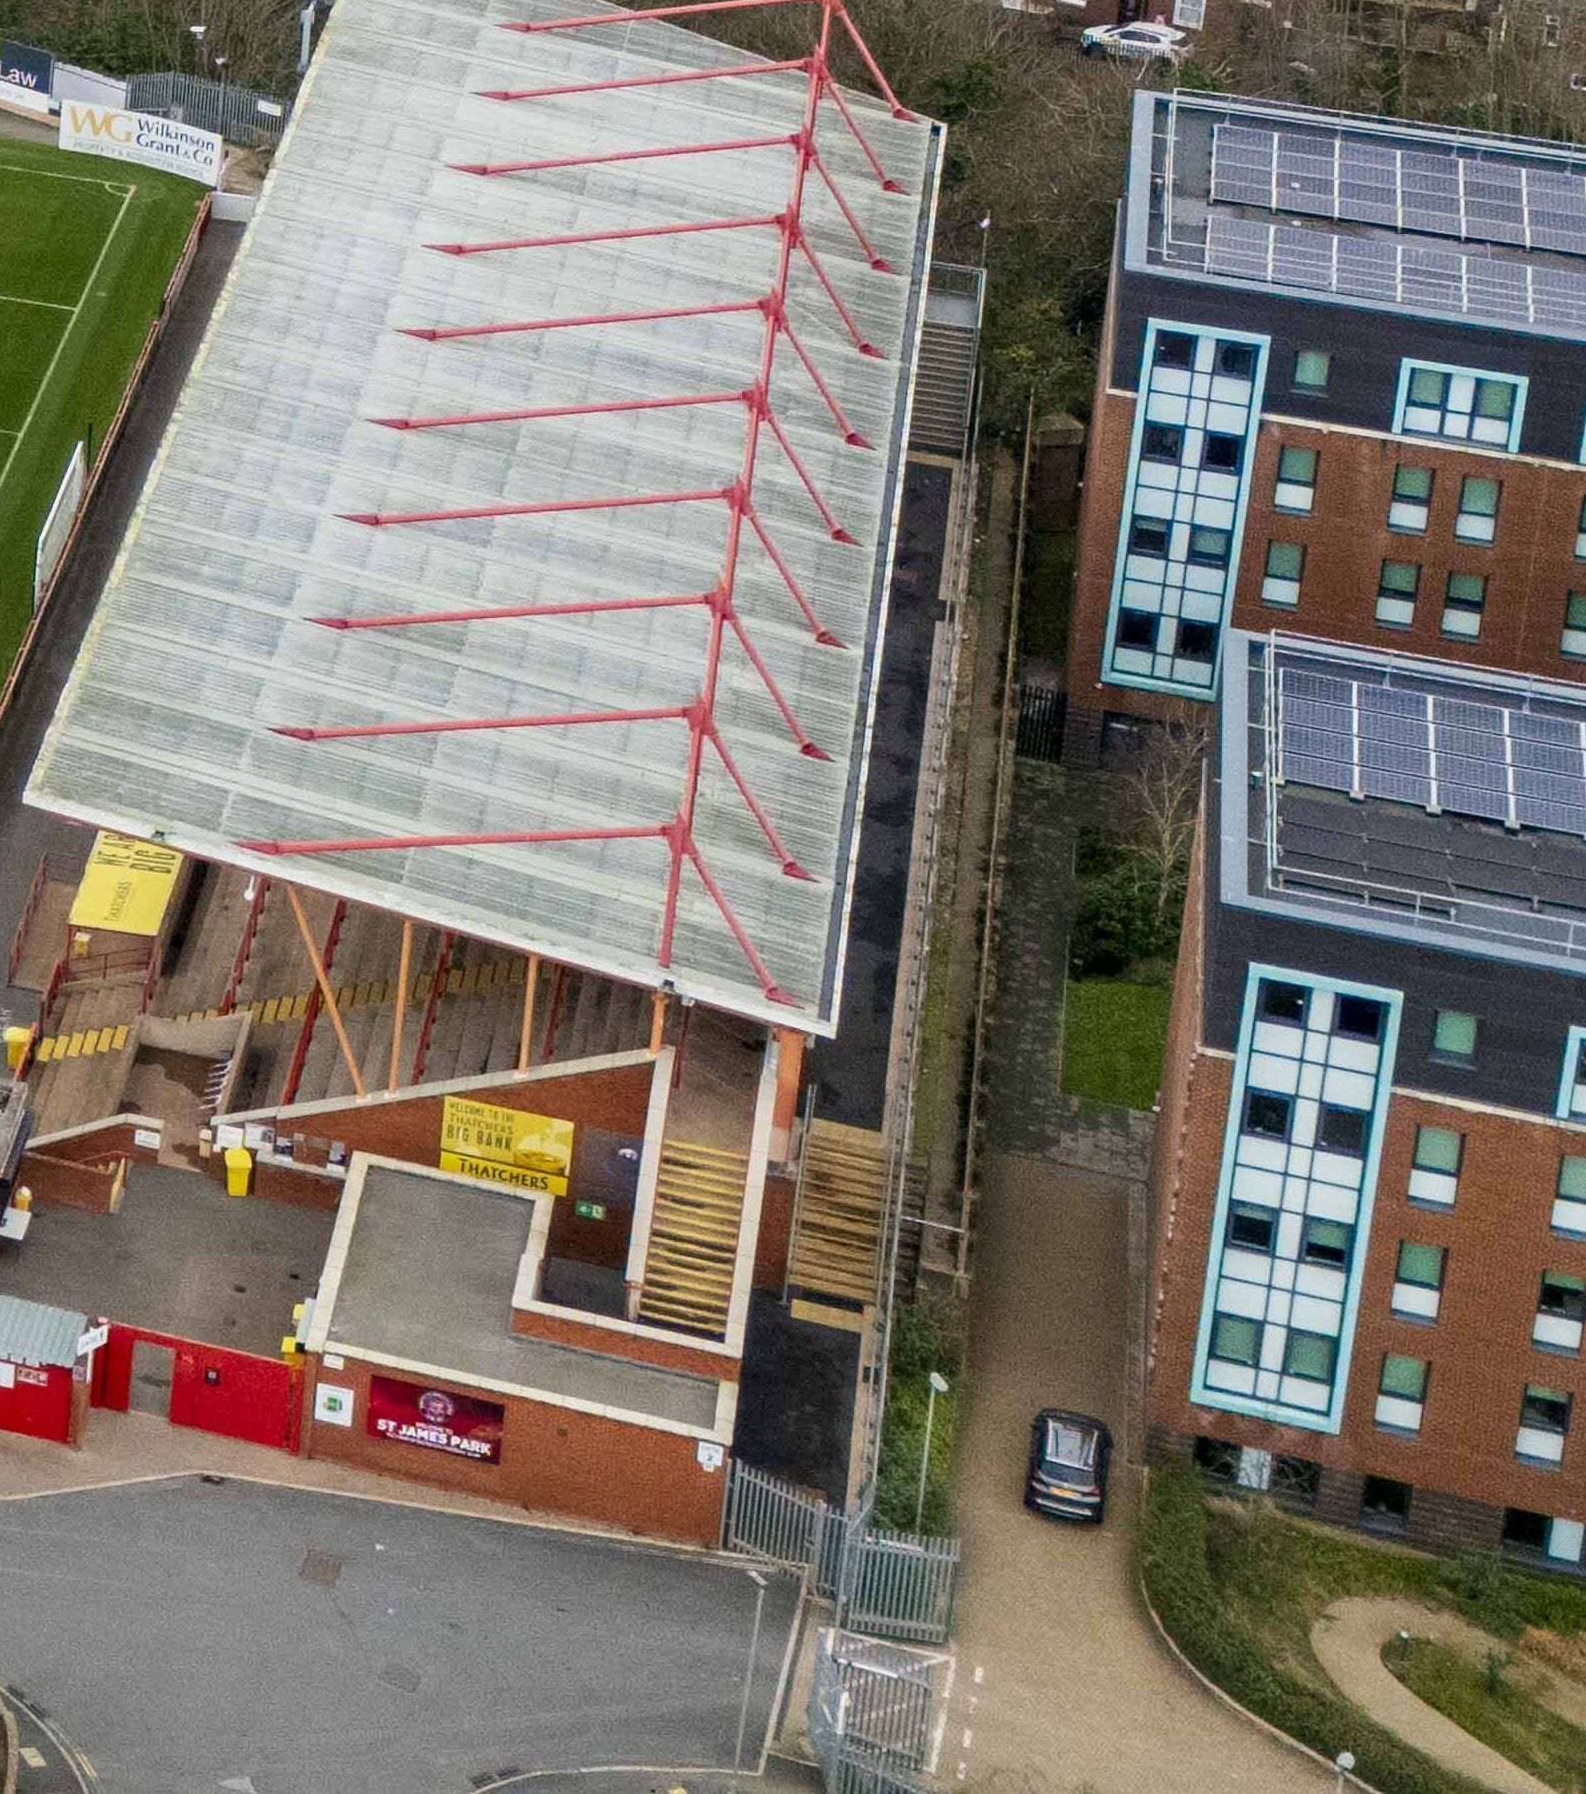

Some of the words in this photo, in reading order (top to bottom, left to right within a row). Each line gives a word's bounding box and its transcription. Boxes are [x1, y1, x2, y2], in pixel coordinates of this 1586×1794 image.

[69, 106, 133, 143] WG
[137, 118, 215, 151] Wilkinson
[136, 134, 180, 156] Grant
[193, 149, 213, 167] Co
[102, 834, 137, 850] AR
[94, 851, 132, 867] WE
[129, 850, 176, 875] BIG
[449, 1101, 485, 1118] WELCOME
[488, 1108, 499, 1120] TO
[501, 1111, 514, 1124] THE
[450, 1112, 514, 1135] THATCHERS
[446, 1124, 470, 1143] BIG
[476, 1130, 514, 1151] BANK
[458, 1158, 548, 1190] THATCHERS
[377, 1418, 397, 1433] ST
[399, 1423, 448, 1445] JAMES
[450, 1435, 492, 1455] PARK
